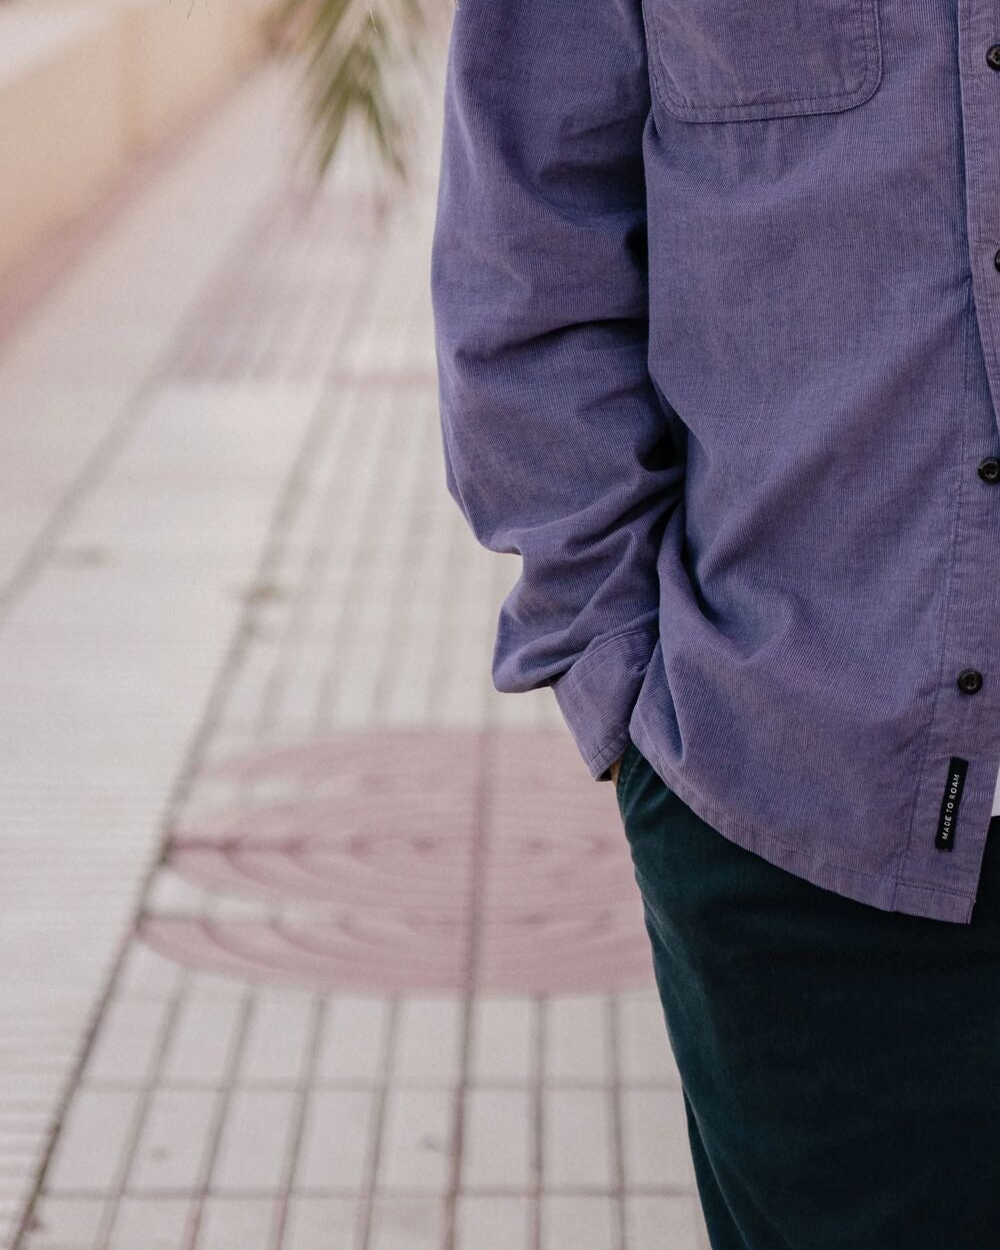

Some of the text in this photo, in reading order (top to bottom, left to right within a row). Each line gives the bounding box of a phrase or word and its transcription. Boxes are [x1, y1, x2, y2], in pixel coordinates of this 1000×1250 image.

[942, 774, 960, 840] MADE TO ROAM
